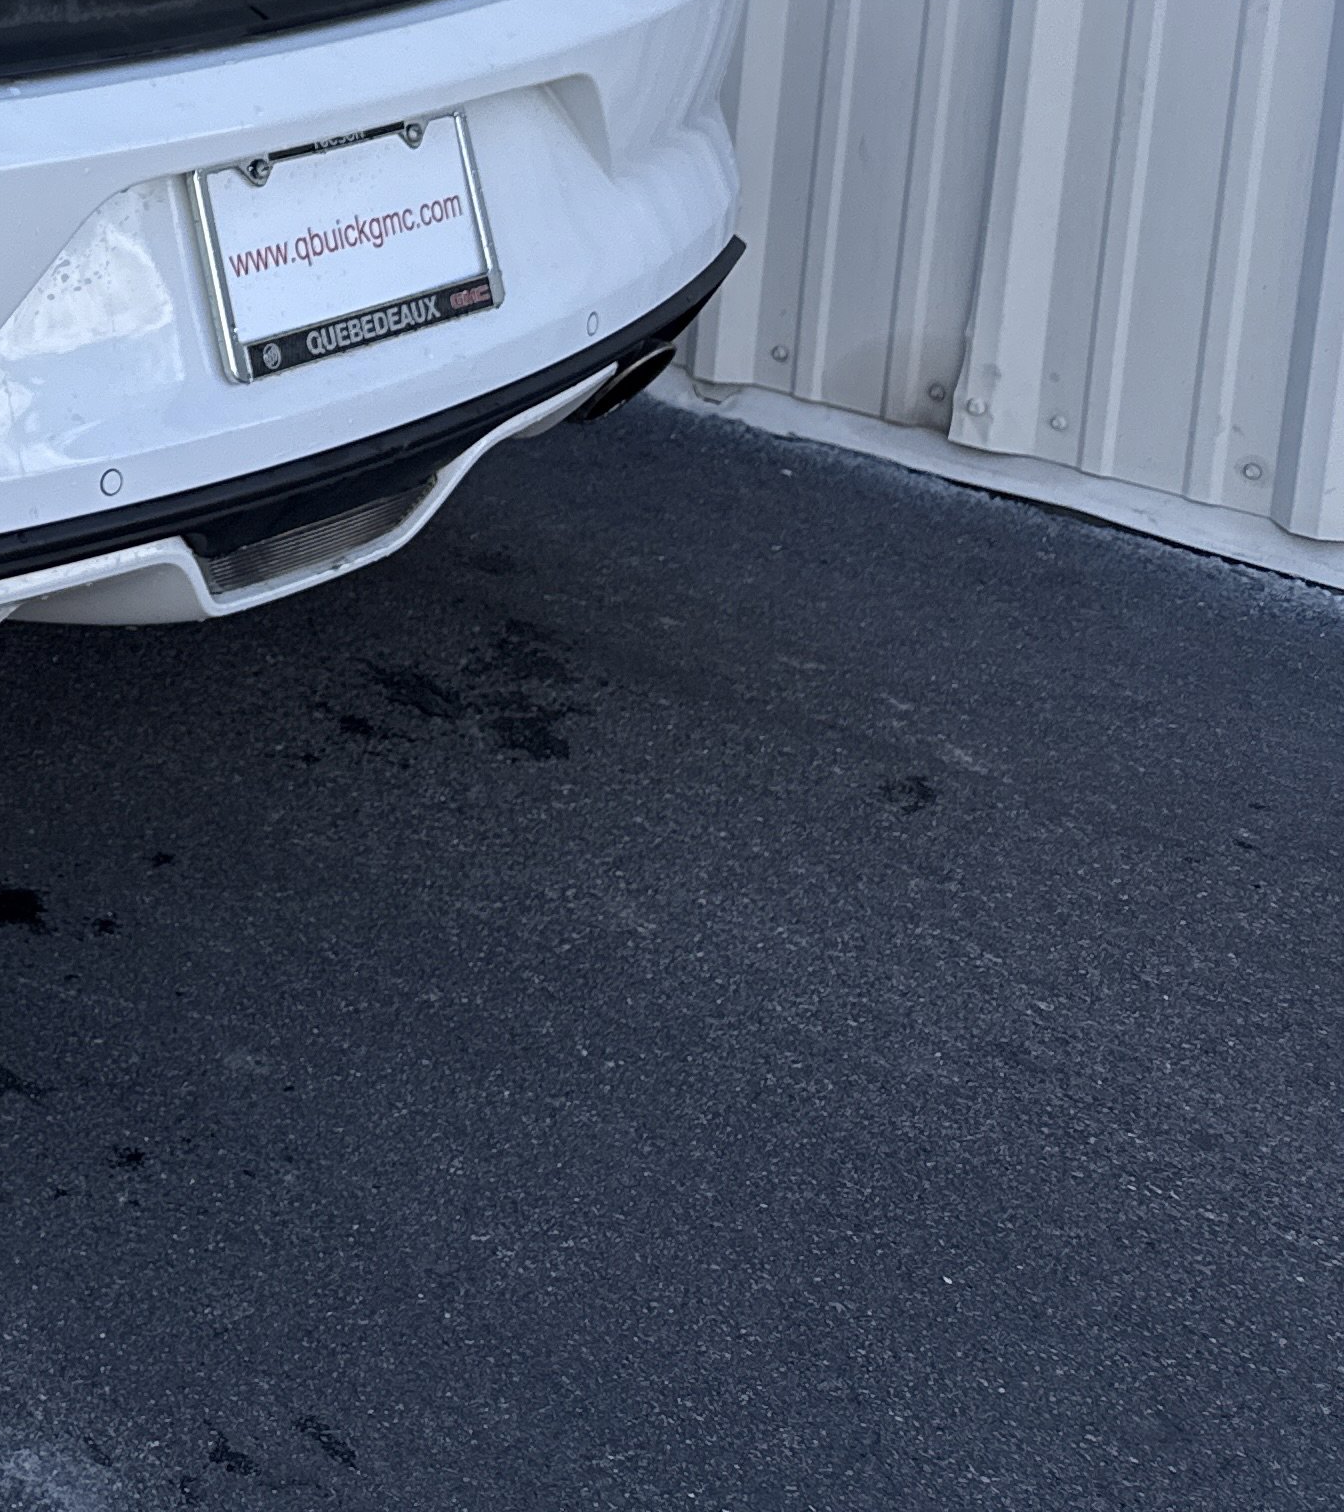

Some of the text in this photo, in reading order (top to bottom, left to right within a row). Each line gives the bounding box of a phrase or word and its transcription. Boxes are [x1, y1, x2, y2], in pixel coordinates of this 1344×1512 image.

[229, 194, 463, 278] www.qbuickgmc.com
[306, 284, 490, 356] QUEBEDEAUX GMC
